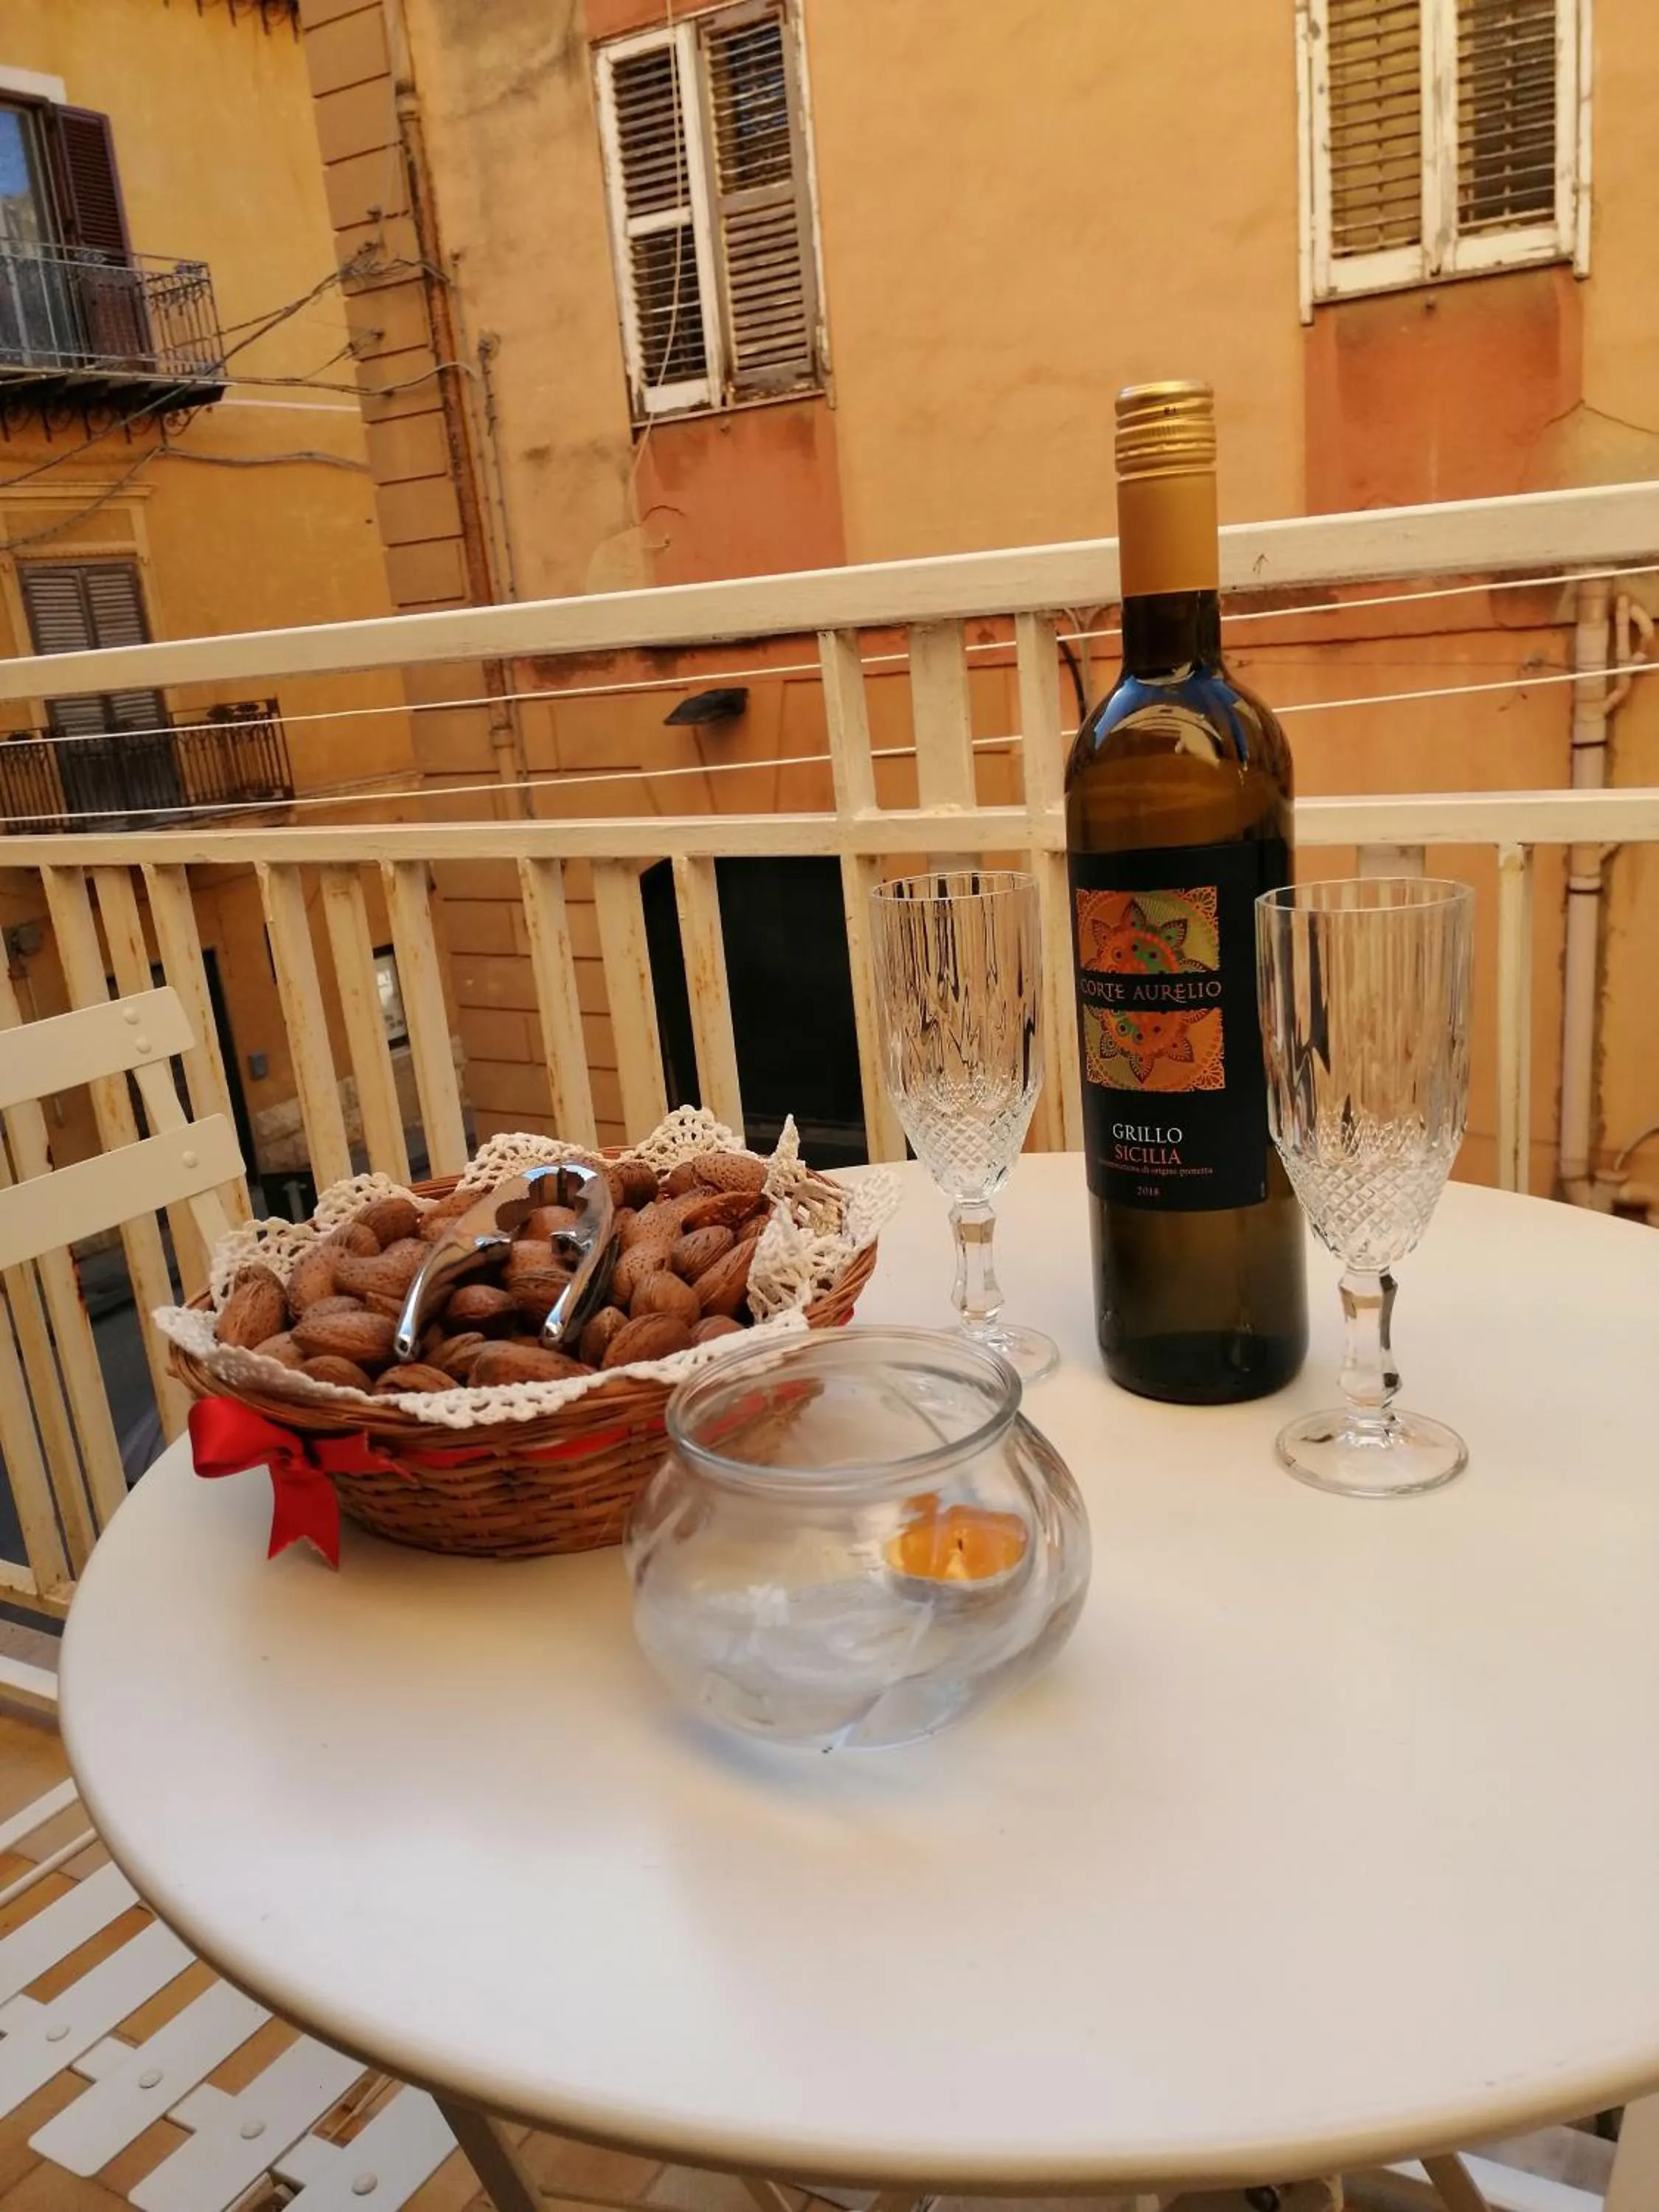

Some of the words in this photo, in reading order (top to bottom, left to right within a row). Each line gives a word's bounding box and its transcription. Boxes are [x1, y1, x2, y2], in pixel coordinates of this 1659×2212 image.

[1080, 978, 1126, 1002] CORTE
[1133, 981, 1222, 1004] AURELIO
[1113, 1123, 1183, 1144] GRILLO
[1114, 1144, 1183, 1164] SICILIA
